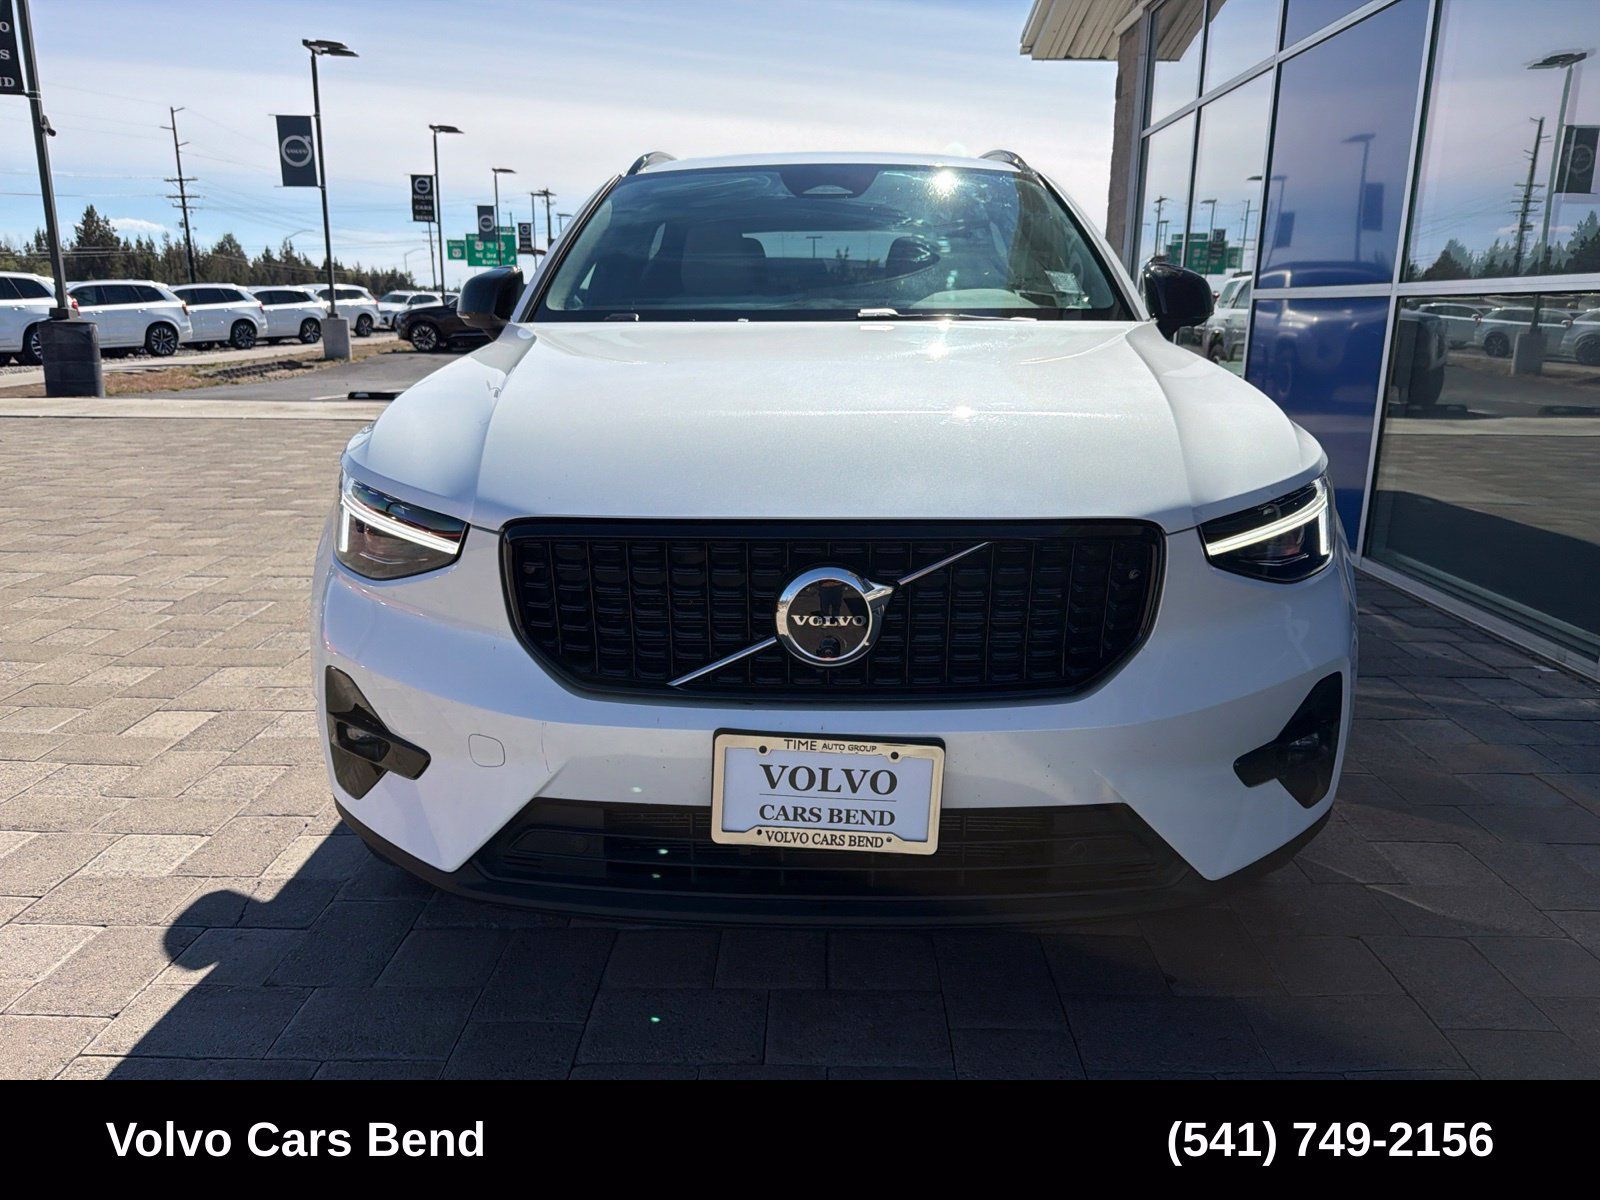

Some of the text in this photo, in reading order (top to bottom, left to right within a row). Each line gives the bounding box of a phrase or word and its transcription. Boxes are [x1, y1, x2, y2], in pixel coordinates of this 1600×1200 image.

[791, 614, 867, 627] VOLVO
[784, 738, 877, 753] TIME AUTO GROUP
[759, 763, 898, 796] VOLVO
[759, 804, 896, 827] CARS BEND
[765, 830, 884, 849] VOLVO CARS BEND
